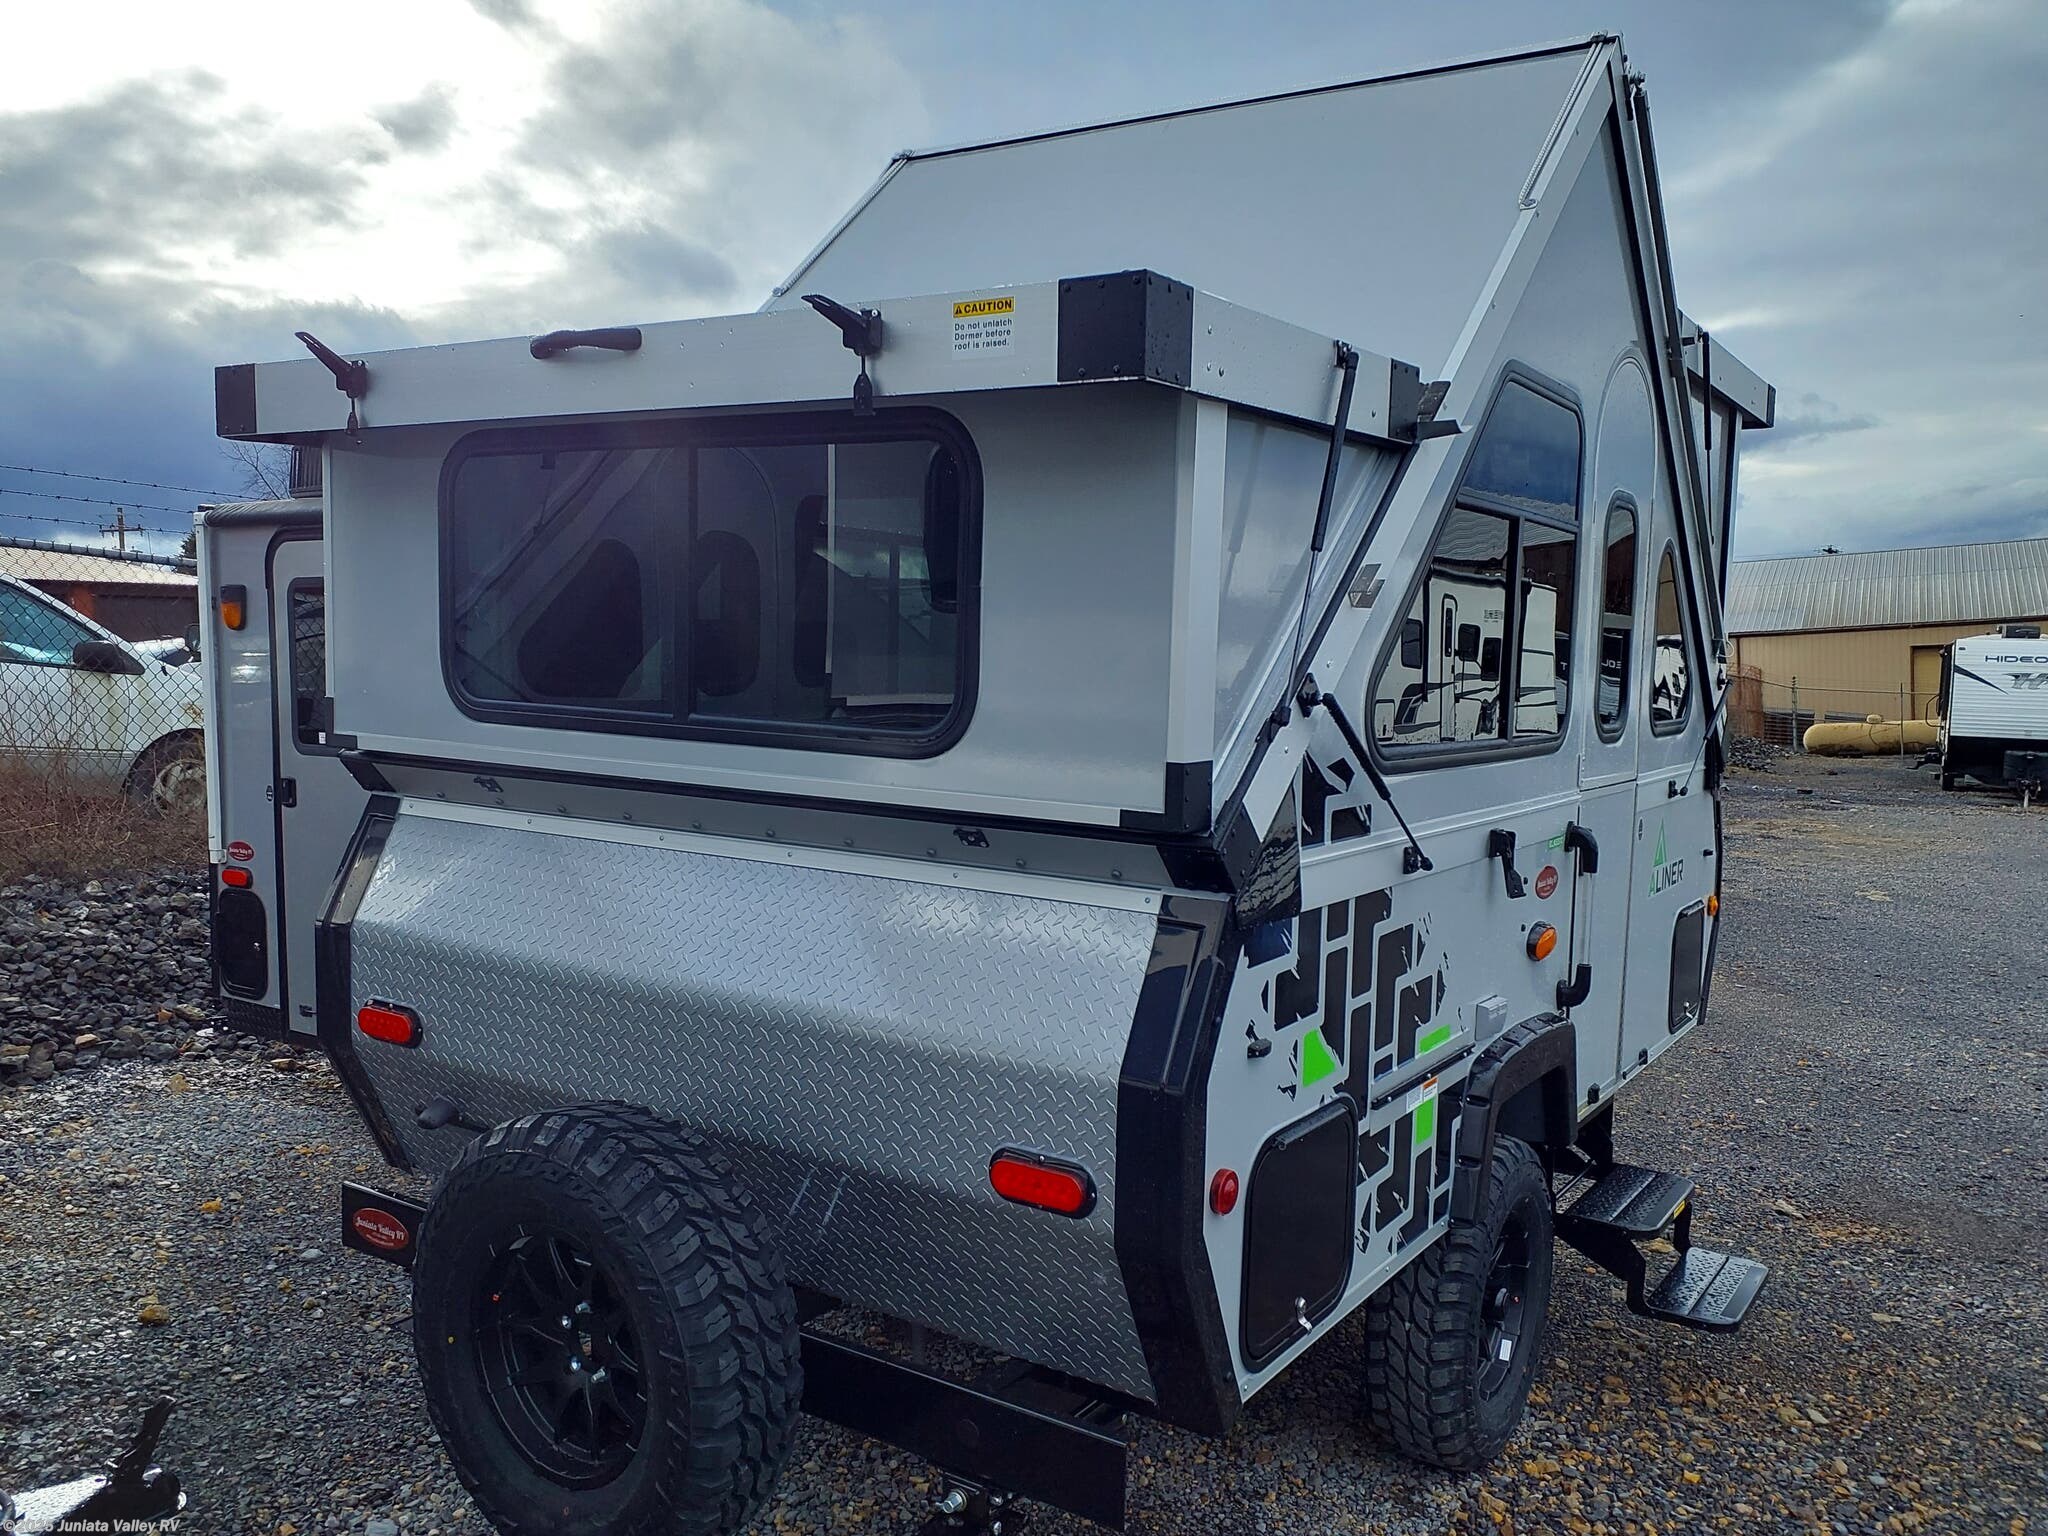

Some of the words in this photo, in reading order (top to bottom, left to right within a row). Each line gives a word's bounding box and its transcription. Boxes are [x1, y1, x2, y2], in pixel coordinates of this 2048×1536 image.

[964, 299, 1012, 314] CAUTION
[955, 323, 965, 331] Do
[967, 321, 980, 330] not
[982, 318, 1013, 328] unlatch
[954, 332, 982, 341] Dormer
[985, 329, 1011, 338] before
[954, 341, 971, 350] roof
[973, 341, 980, 349] is
